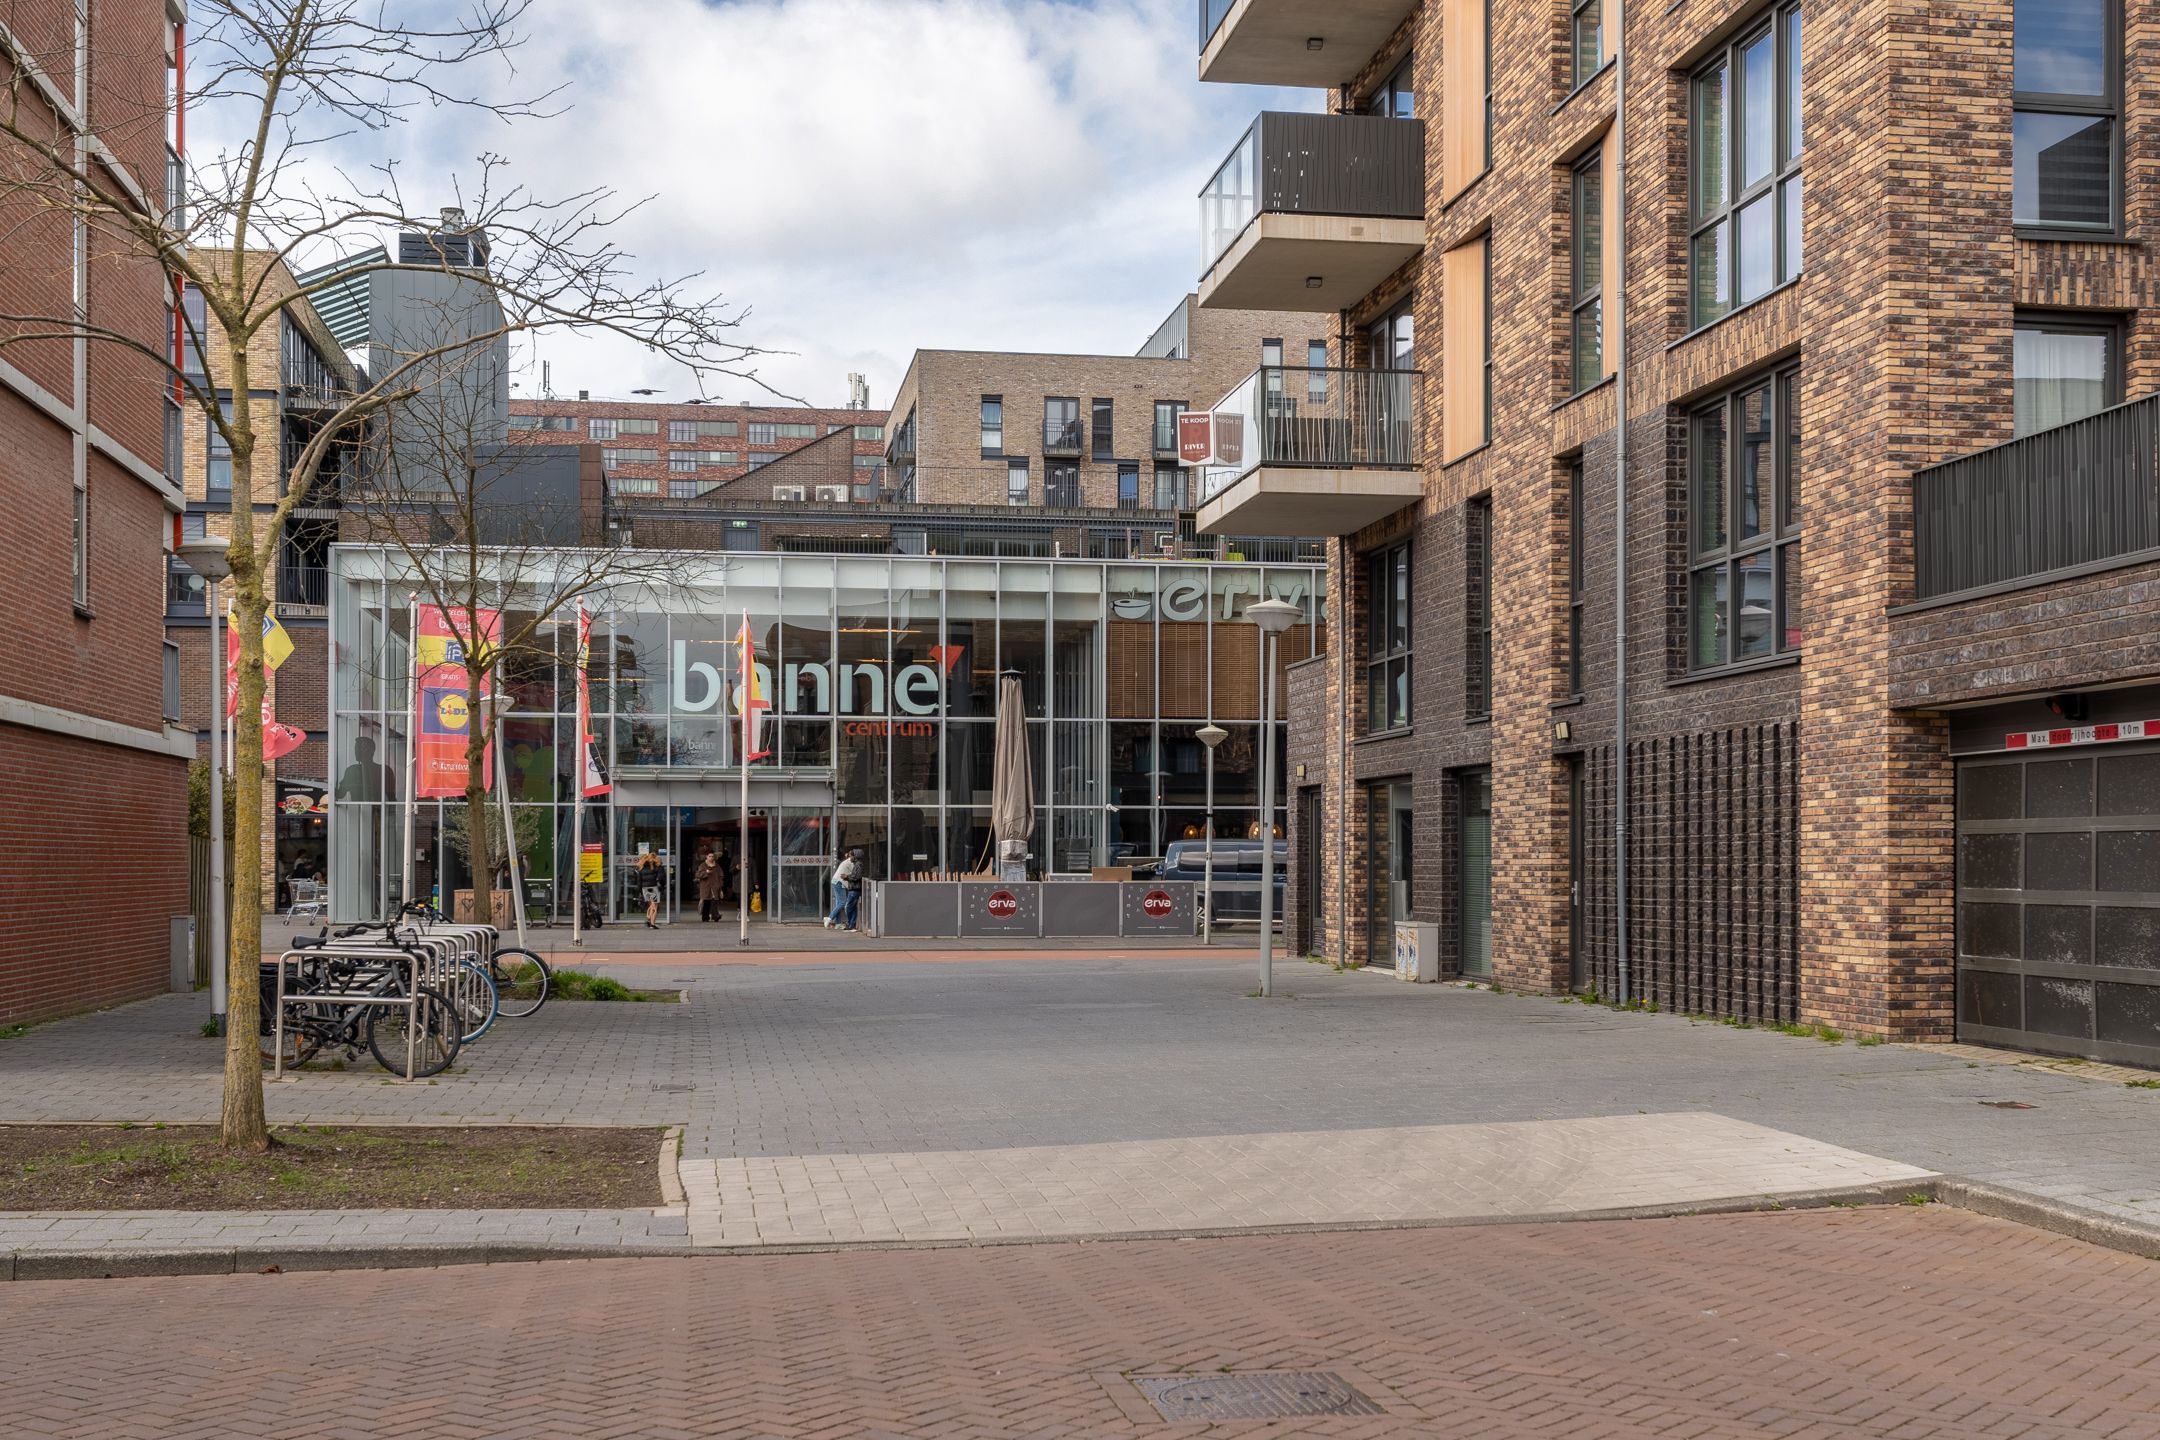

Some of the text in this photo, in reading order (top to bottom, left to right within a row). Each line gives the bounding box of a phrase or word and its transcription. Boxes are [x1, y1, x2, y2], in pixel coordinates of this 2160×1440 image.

[1161, 577, 1327, 621] erv
[845, 721, 933, 737] centrum
[2031, 734, 2049, 743] Max.
[988, 898, 1016, 908] erva
[1144, 898, 1171, 908] erva
